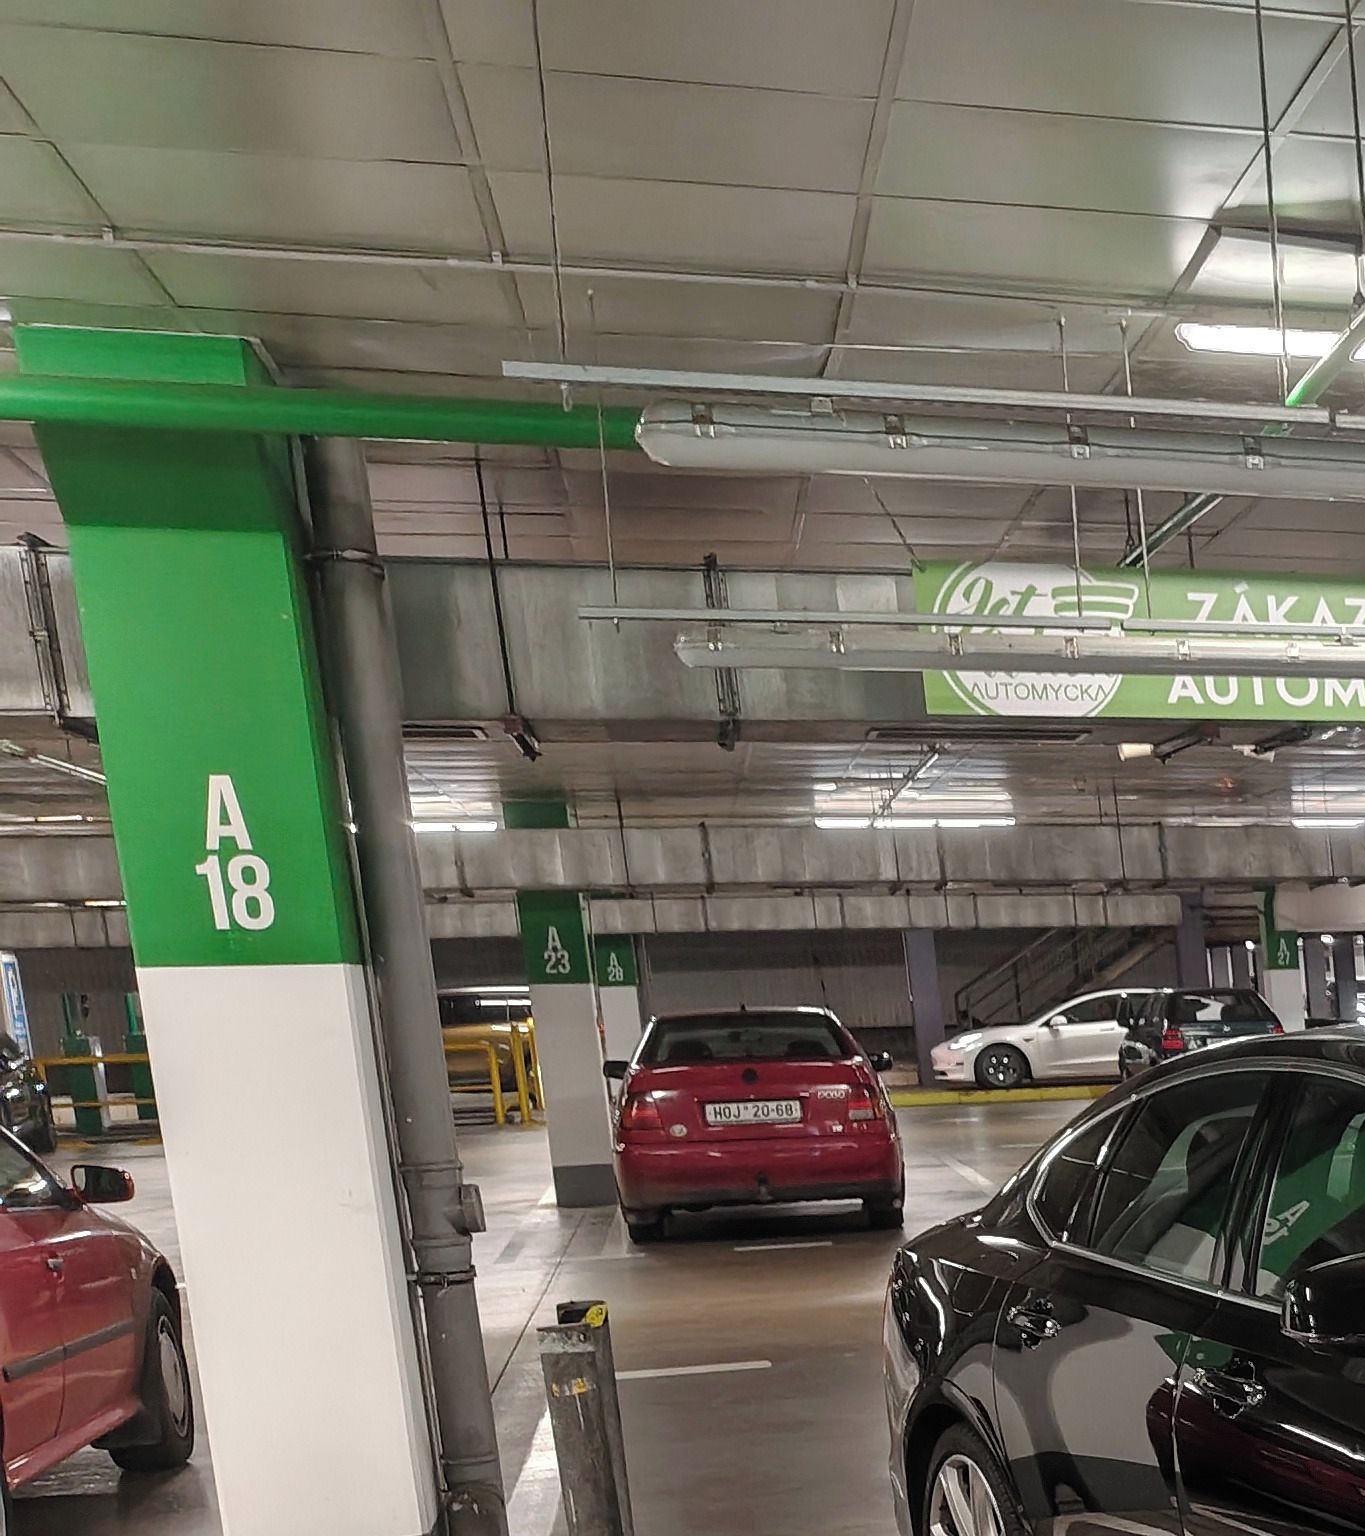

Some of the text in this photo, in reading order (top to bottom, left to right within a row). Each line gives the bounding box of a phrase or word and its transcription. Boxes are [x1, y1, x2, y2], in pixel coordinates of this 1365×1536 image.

[206, 774, 253, 850] A
[195, 854, 275, 930] 18
[547, 926, 562, 950] A
[1280, 938, 1288, 953] A
[543, 949, 571, 974] 23
[609, 952, 620, 967] A
[1277, 951, 1290, 966] 27
[713, 1105, 741, 1120] HOJ
